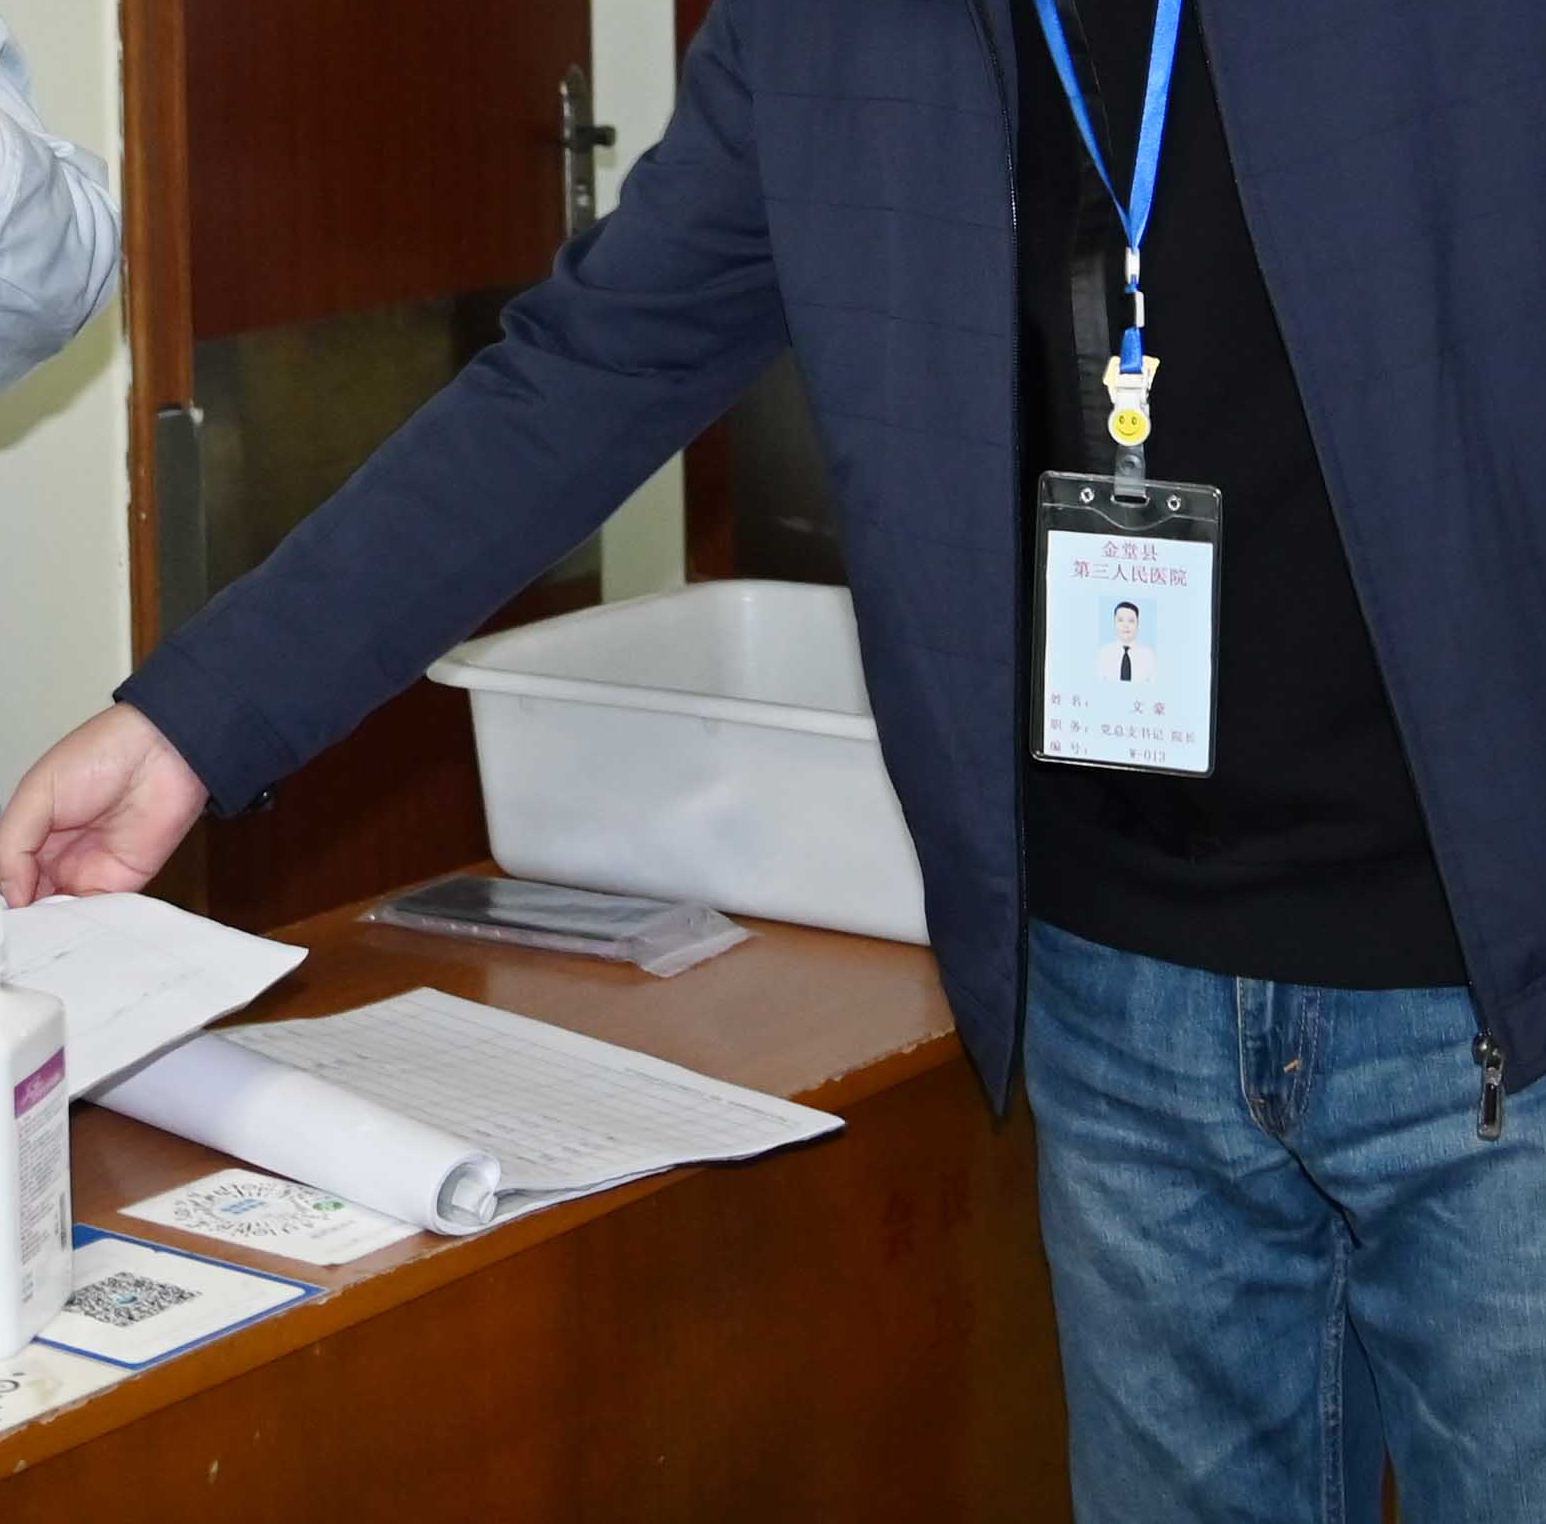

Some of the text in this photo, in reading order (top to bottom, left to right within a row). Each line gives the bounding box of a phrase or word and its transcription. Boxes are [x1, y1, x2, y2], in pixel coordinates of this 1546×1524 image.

[1102, 539, 1158, 562] 金堂县
[1071, 559, 1189, 588] 第三人民医院
